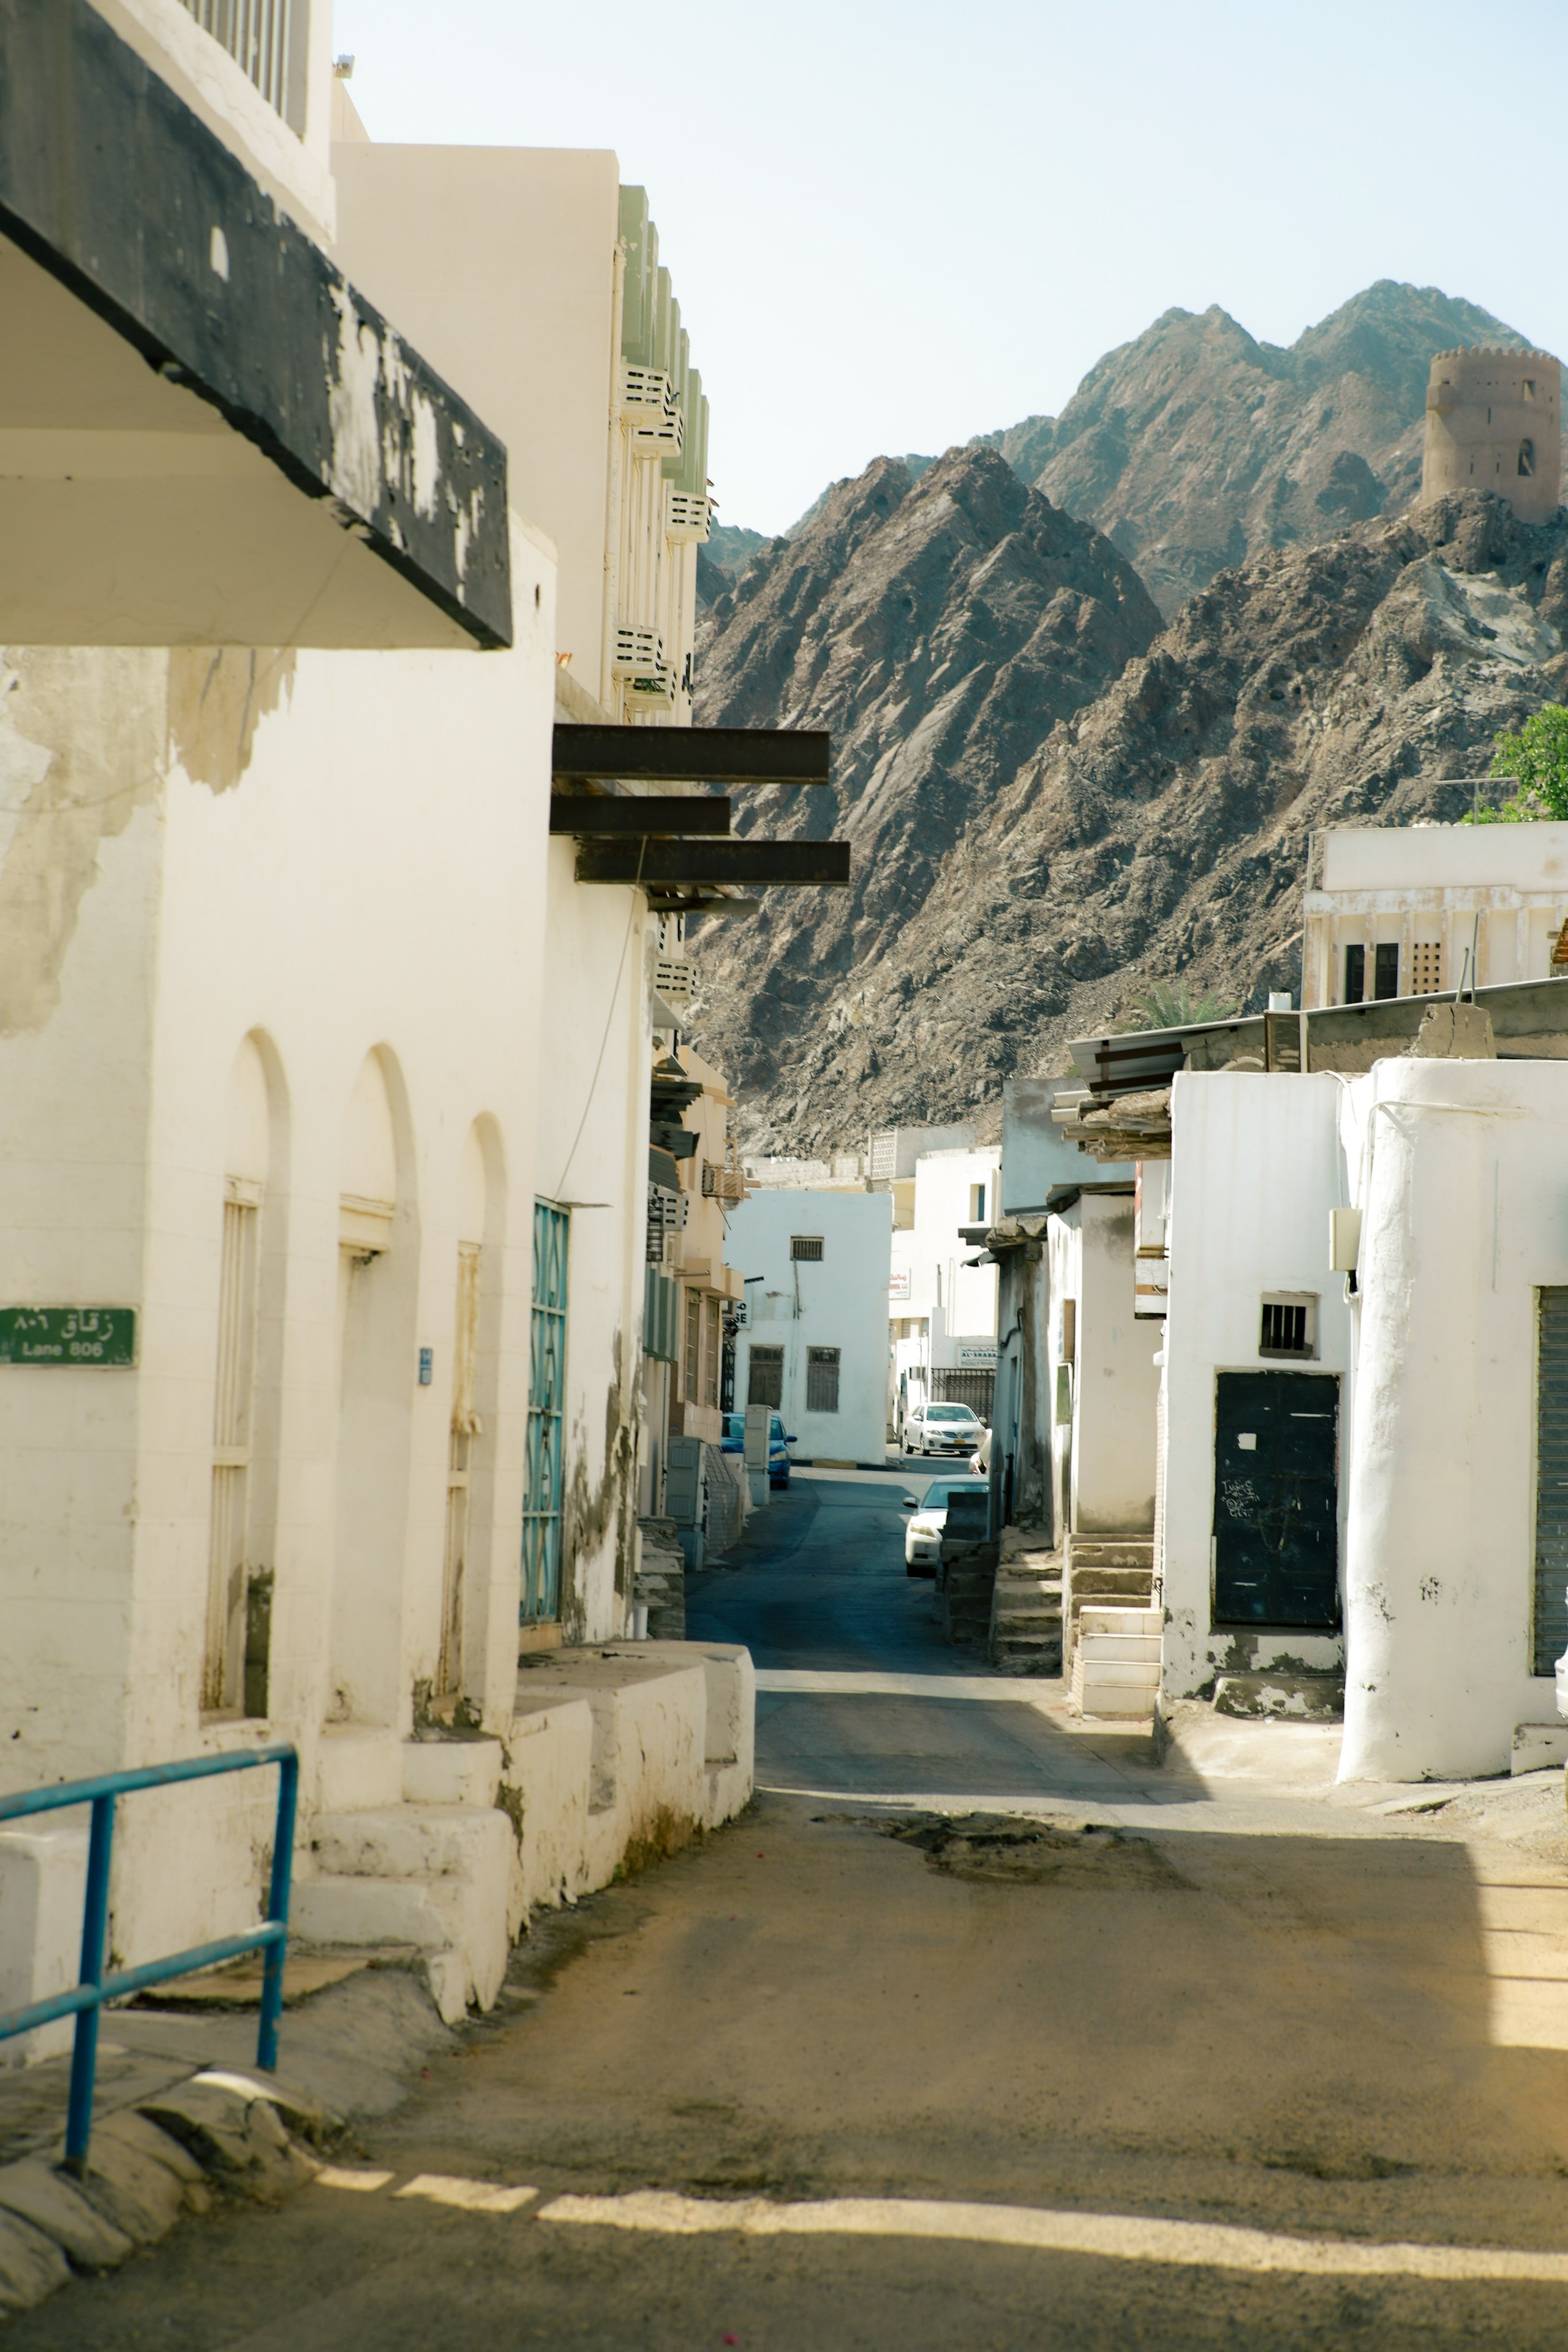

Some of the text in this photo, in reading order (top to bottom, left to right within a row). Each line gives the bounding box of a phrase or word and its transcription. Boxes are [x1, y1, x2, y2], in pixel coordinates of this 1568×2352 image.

[60, 1310, 114, 1341] زقاق
[23, 1341, 63, 1357] Lane
[69, 1341, 104, 1358] 806
